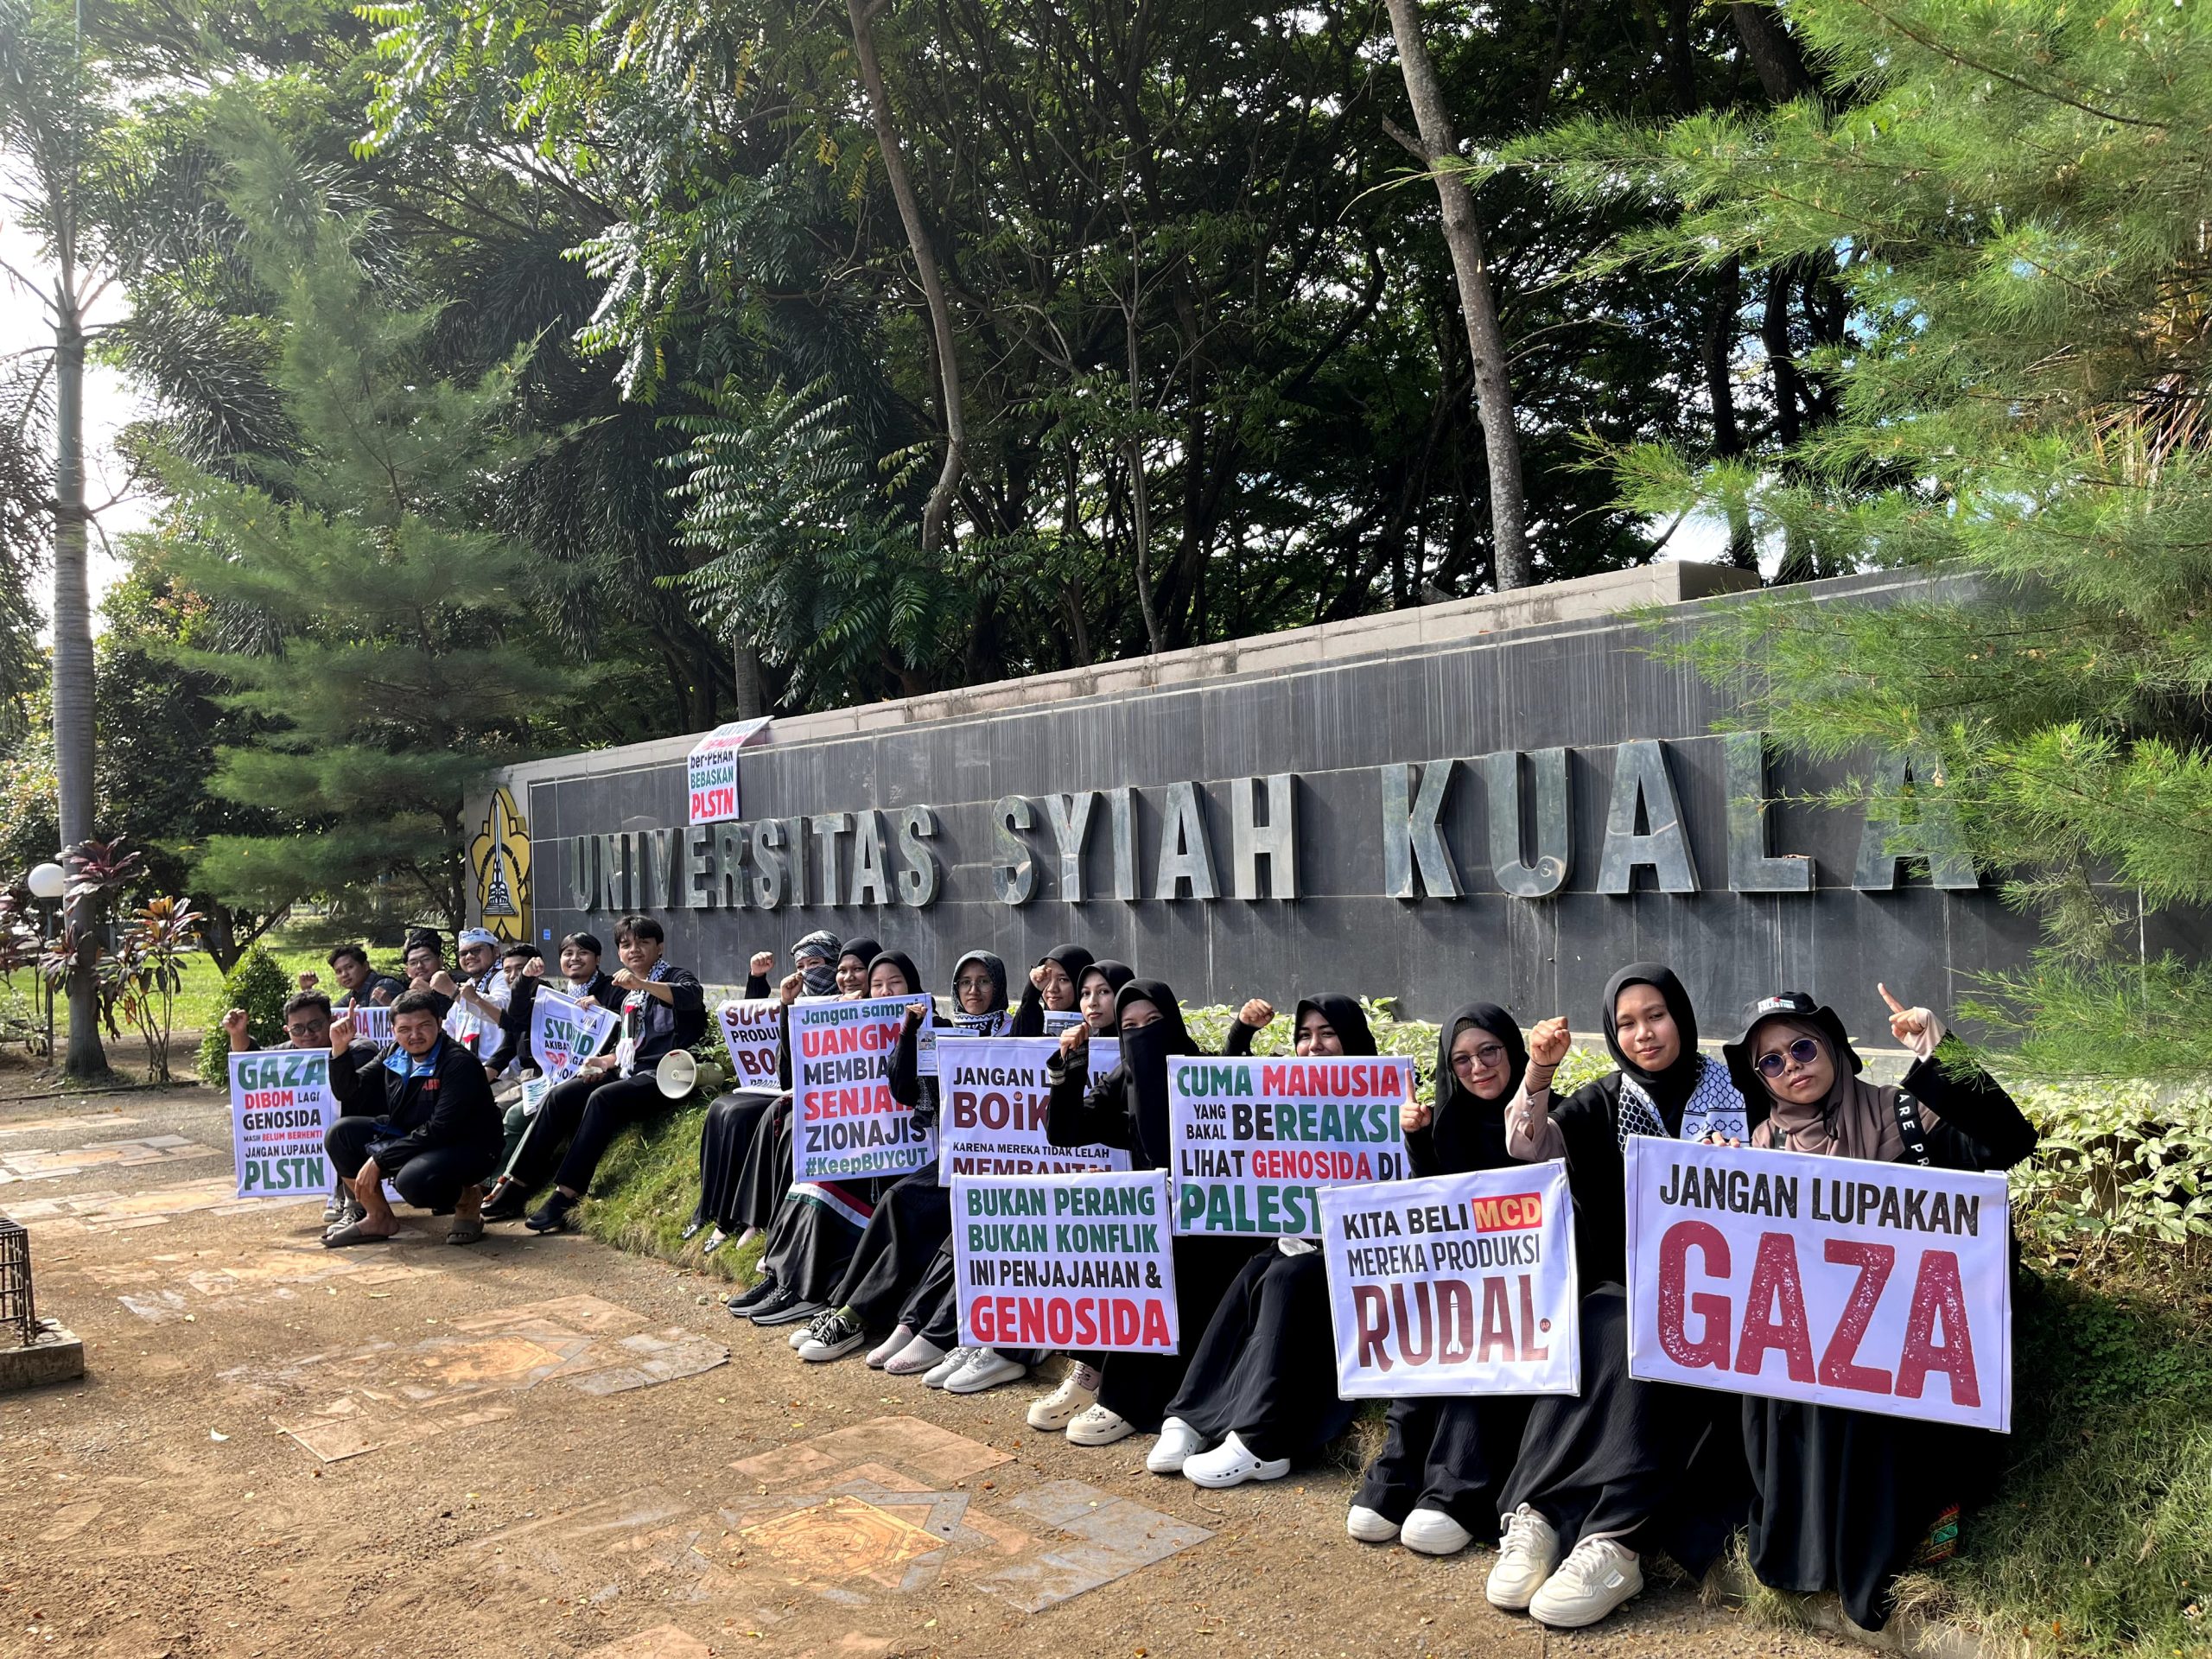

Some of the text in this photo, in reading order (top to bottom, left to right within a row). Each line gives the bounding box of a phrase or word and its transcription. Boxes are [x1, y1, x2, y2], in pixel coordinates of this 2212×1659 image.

[690, 766, 734, 789] BEBASKAN
[691, 787, 734, 819] PLSTN
[570, 731, 1980, 912] UNIVERSITAS SYIAH KUALA
[726, 1003, 780, 1027] SUPP
[802, 998, 918, 1027] Jangan samp
[730, 1027, 781, 1043] PRODU
[802, 1022, 900, 1058] UANGM
[238, 1054, 327, 1090] GAZA
[804, 1055, 889, 1086] MEMBIA
[953, 1067, 1038, 1087] JANGAN
[1176, 1065, 1401, 1097] CUMA MANUSIA
[245, 1090, 321, 1109] DIBOM LAGI
[804, 1085, 913, 1121] SENJA
[1193, 1103, 1226, 1120] YANG
[243, 1109, 321, 1130] GENOSIDA
[1186, 1123, 1227, 1140] BAKAL
[1232, 1103, 1401, 1142] BEREAKSI
[245, 1142, 323, 1158] JANGAN LUPAKAN
[262, 1132, 285, 1141] BELUM
[287, 1130, 323, 1141] BERHENTI
[805, 1117, 926, 1154] ZIONAJIS
[953, 1141, 1109, 1159] KARENA MEREKA TIDAK LELAH
[244, 1157, 325, 1191] PLSTN
[805, 1147, 928, 1176] #KeepBUYCUT
[1181, 1149, 1402, 1181] LIHAT GENOSIDA DI
[967, 1186, 1155, 1217] BUKAN PERANG
[1180, 1184, 1324, 1236] PALEST
[1660, 1164, 1980, 1236] JANGAN LUPAKAN
[1342, 1197, 1542, 1240] KITA BELI MCD
[968, 1224, 1160, 1253] BUKAN KONFLIK
[1347, 1233, 1540, 1276] MEREKA PRODUKSI
[969, 1260, 1162, 1288] INI PENJAJAHAN &
[969, 1295, 1171, 1346] GENOSIDA
[1658, 1220, 1981, 1408] GAZA
